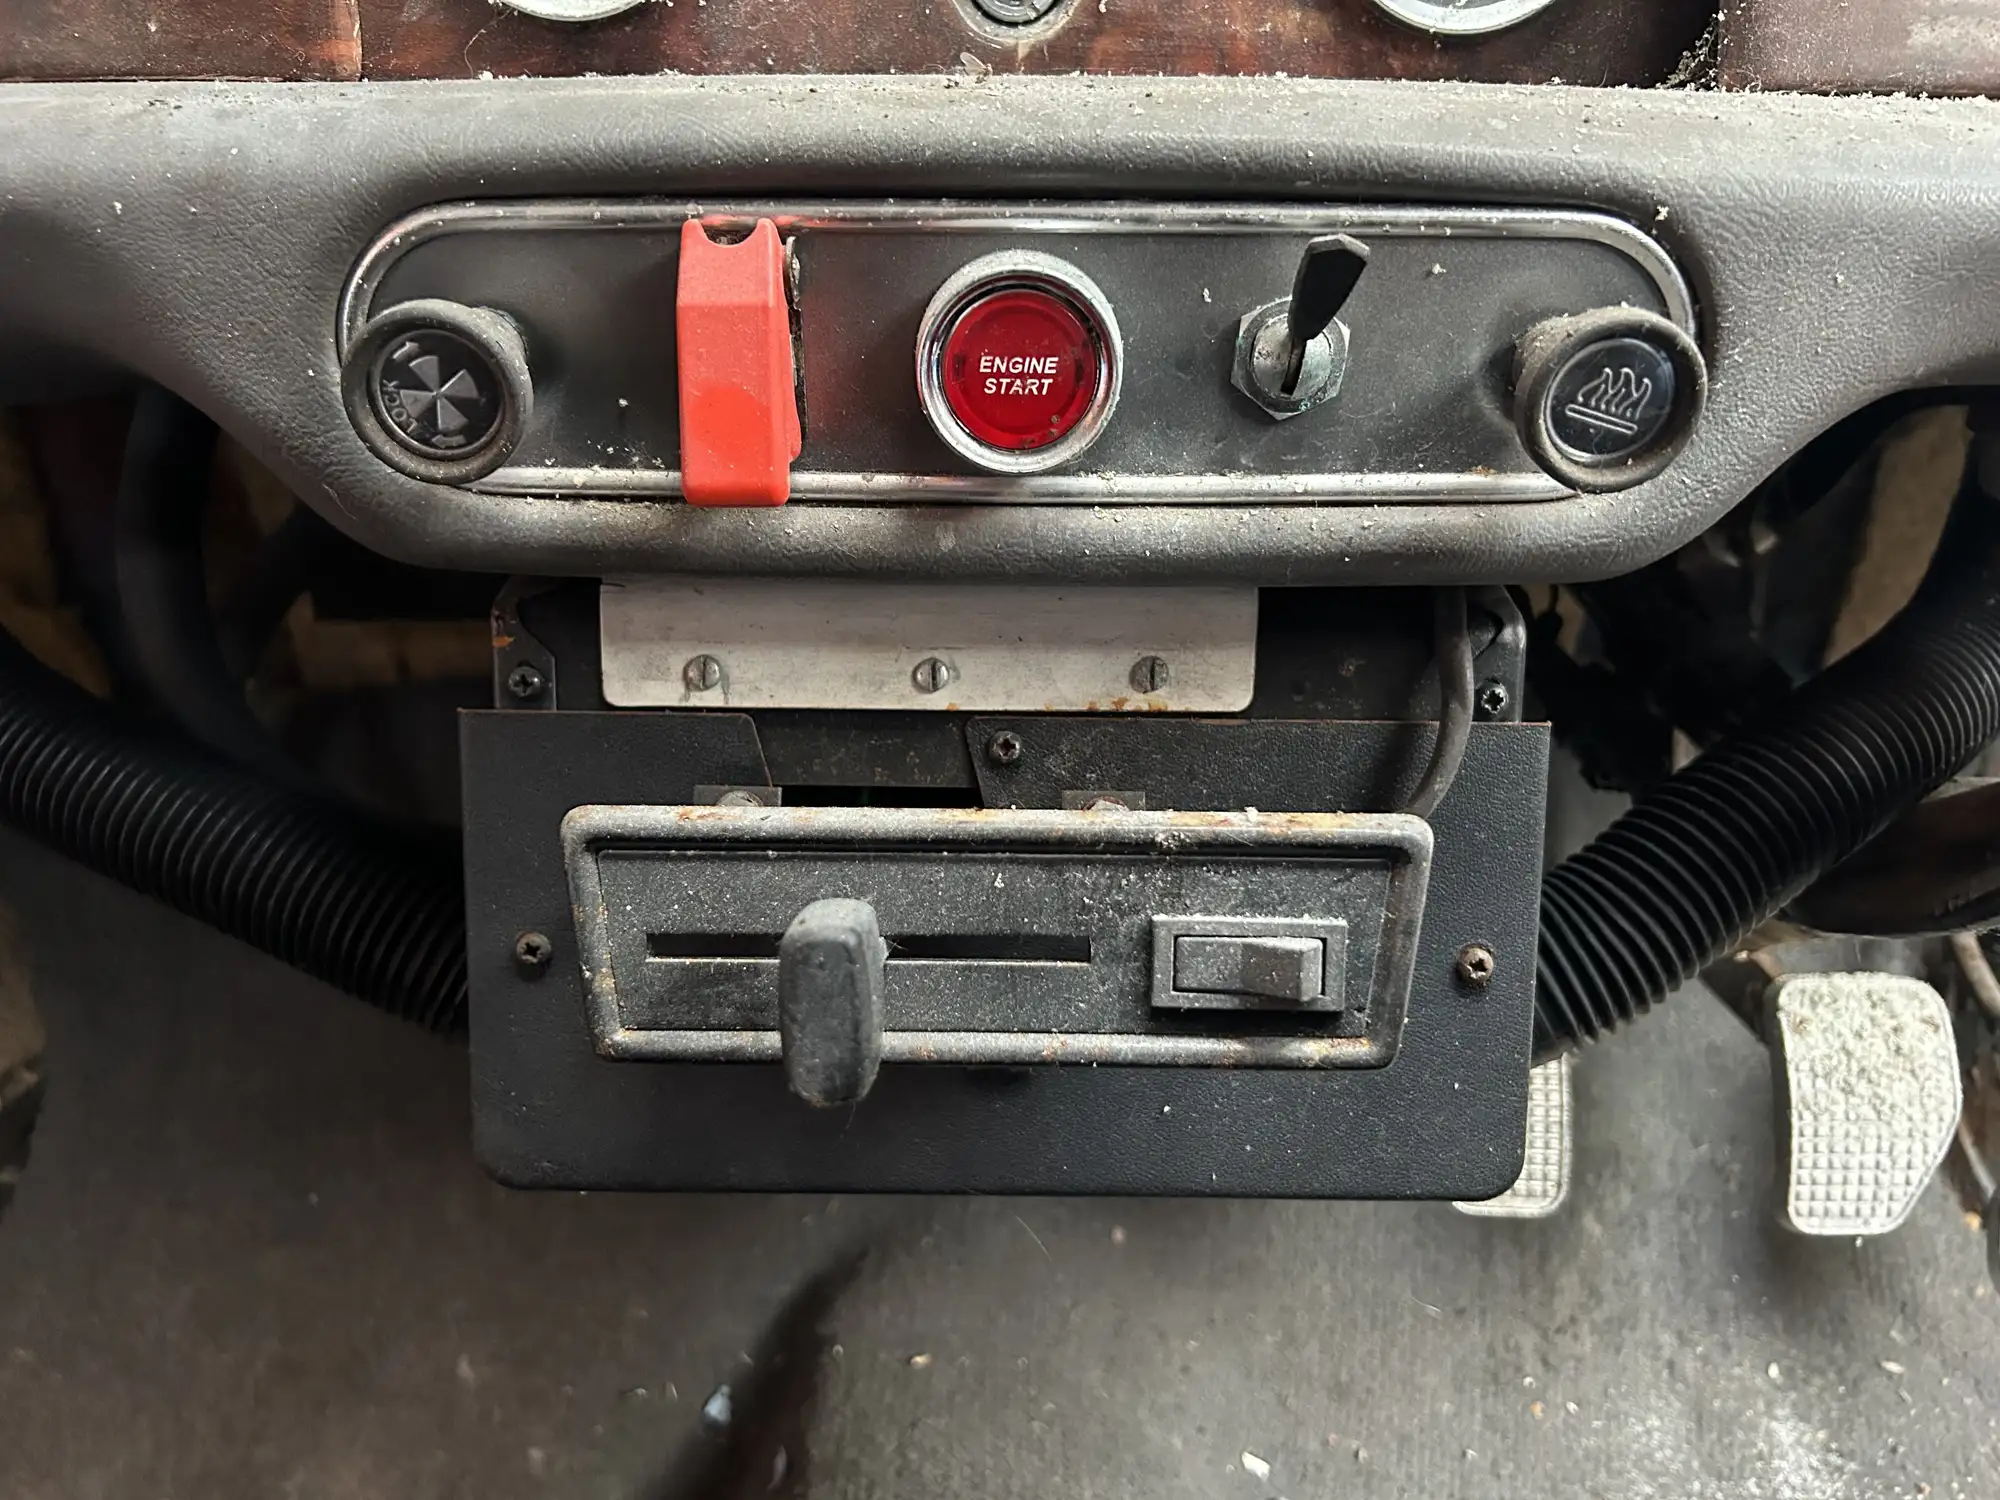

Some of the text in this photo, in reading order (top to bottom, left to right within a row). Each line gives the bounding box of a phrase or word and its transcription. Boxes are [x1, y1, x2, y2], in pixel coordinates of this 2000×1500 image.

[979, 355, 1059, 374] ENGINE
[983, 377, 1053, 395] START
[382, 379, 418, 433] LOCK
